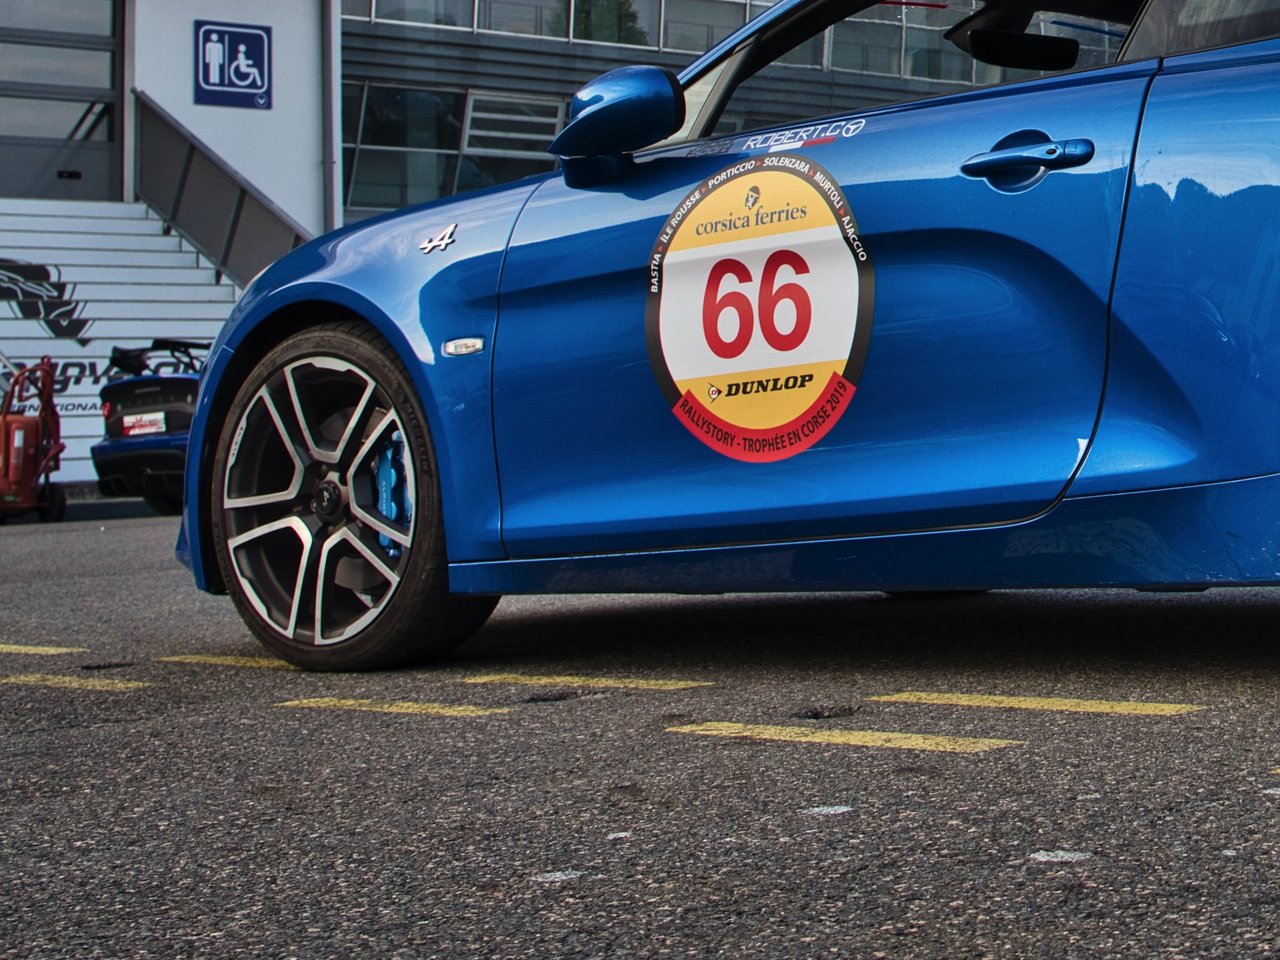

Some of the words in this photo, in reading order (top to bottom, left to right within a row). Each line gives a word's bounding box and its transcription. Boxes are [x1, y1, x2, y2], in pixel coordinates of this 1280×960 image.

[651, 254, 662, 292] BASTIA
[660, 228, 673, 243] ILE
[671, 190, 702, 225] ROUSSE
[708, 160, 755, 189] PORTICCIO
[763, 156, 809, 173] SOLENZARA
[813, 171, 842, 209] MURTOLI
[842, 215, 867, 261] AJACCIO
[695, 212, 750, 236] corsica
[754, 202, 807, 226] ferries
[702, 249, 812, 359] 66
[679, 398, 736, 448] RALLYSTORY
[742, 433, 787, 452] TROPHÉE
[788, 431, 802, 447] EN
[801, 406, 831, 437] CORSE
[829, 381, 847, 411] 2019
[725, 374, 814, 397] DUNLOP
